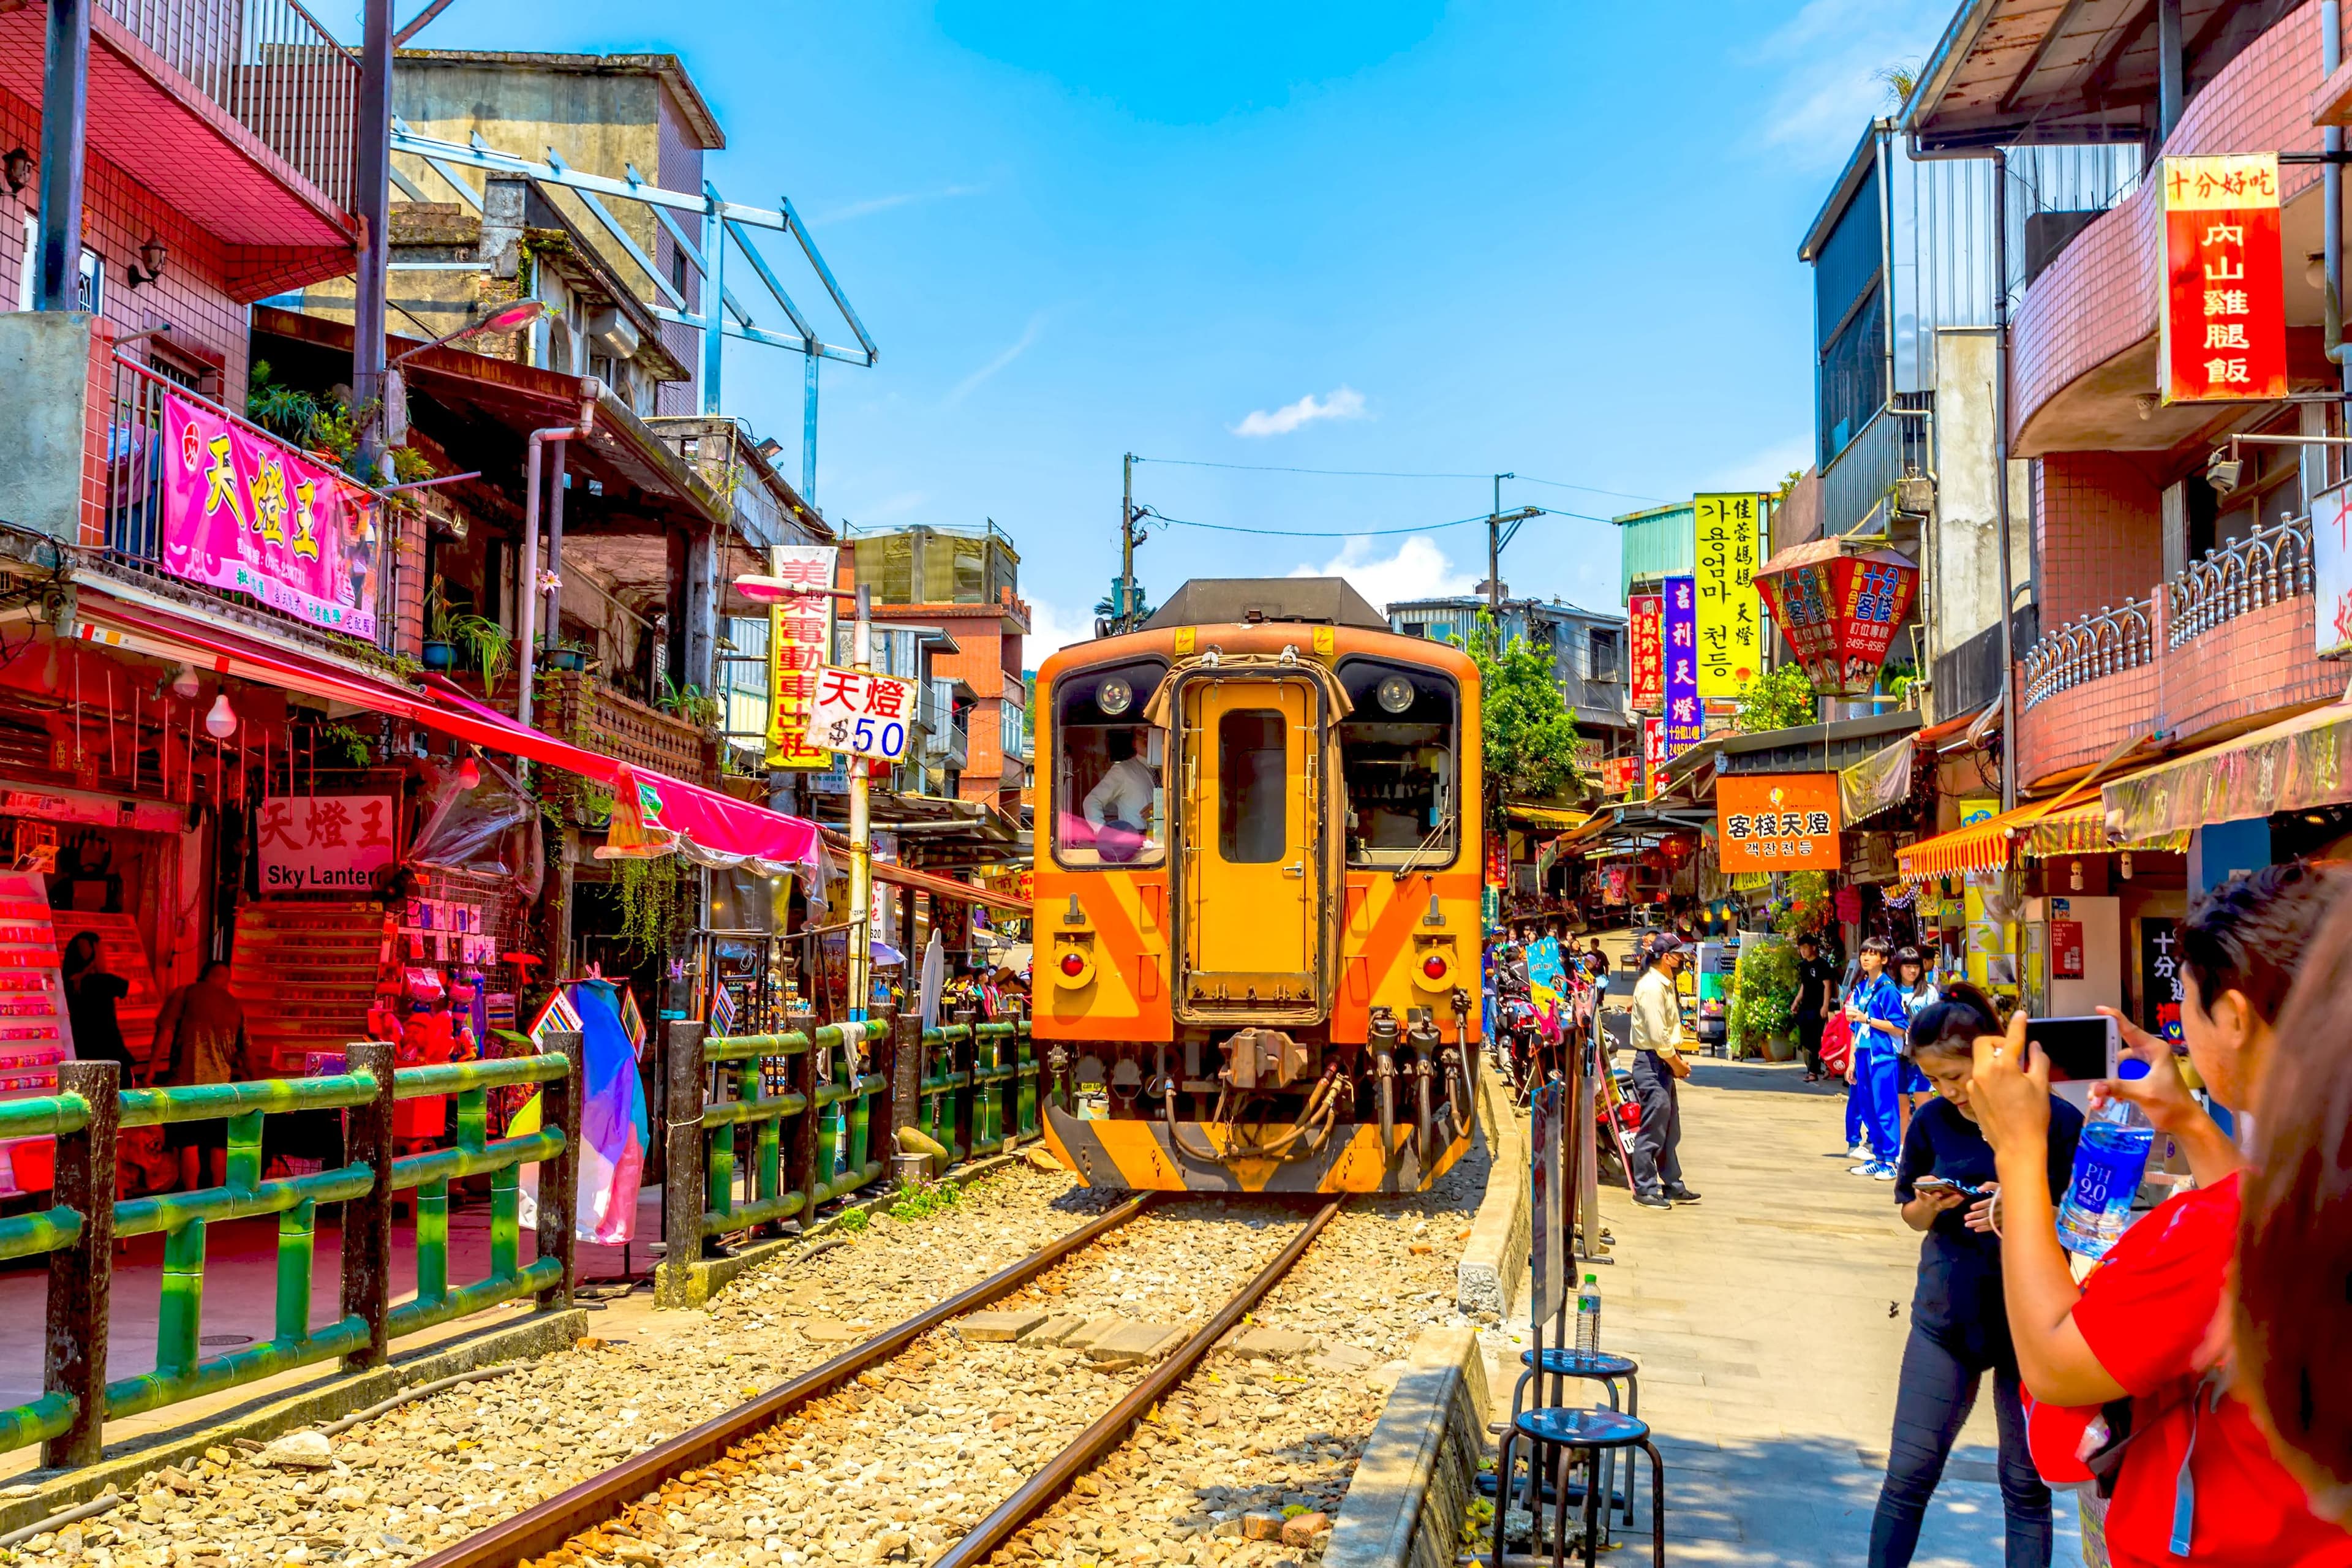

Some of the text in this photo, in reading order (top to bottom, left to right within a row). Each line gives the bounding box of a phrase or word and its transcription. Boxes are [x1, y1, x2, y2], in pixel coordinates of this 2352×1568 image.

[2168, 168, 2275, 201] 十分好吃
[205, 433, 319, 560] 天燈王
[1699, 499, 1733, 677] 가용엄마 천등
[1863, 564, 1899, 596] 十分
[1735, 603, 1754, 646] 天燈
[1855, 592, 1894, 624] 客棧
[1672, 583, 1697, 723] 吉利天燈
[820, 671, 905, 719] 天燈
[828, 717, 904, 756] $50
[257, 798, 392, 851] 天燈王
[1728, 813, 1830, 839] 客棧天燈
[268, 865, 304, 889] Sky
[2153, 932, 2176, 978] 十分
[2080, 1178, 2106, 1202] 9.0
[2085, 1163, 2111, 1184] PH
